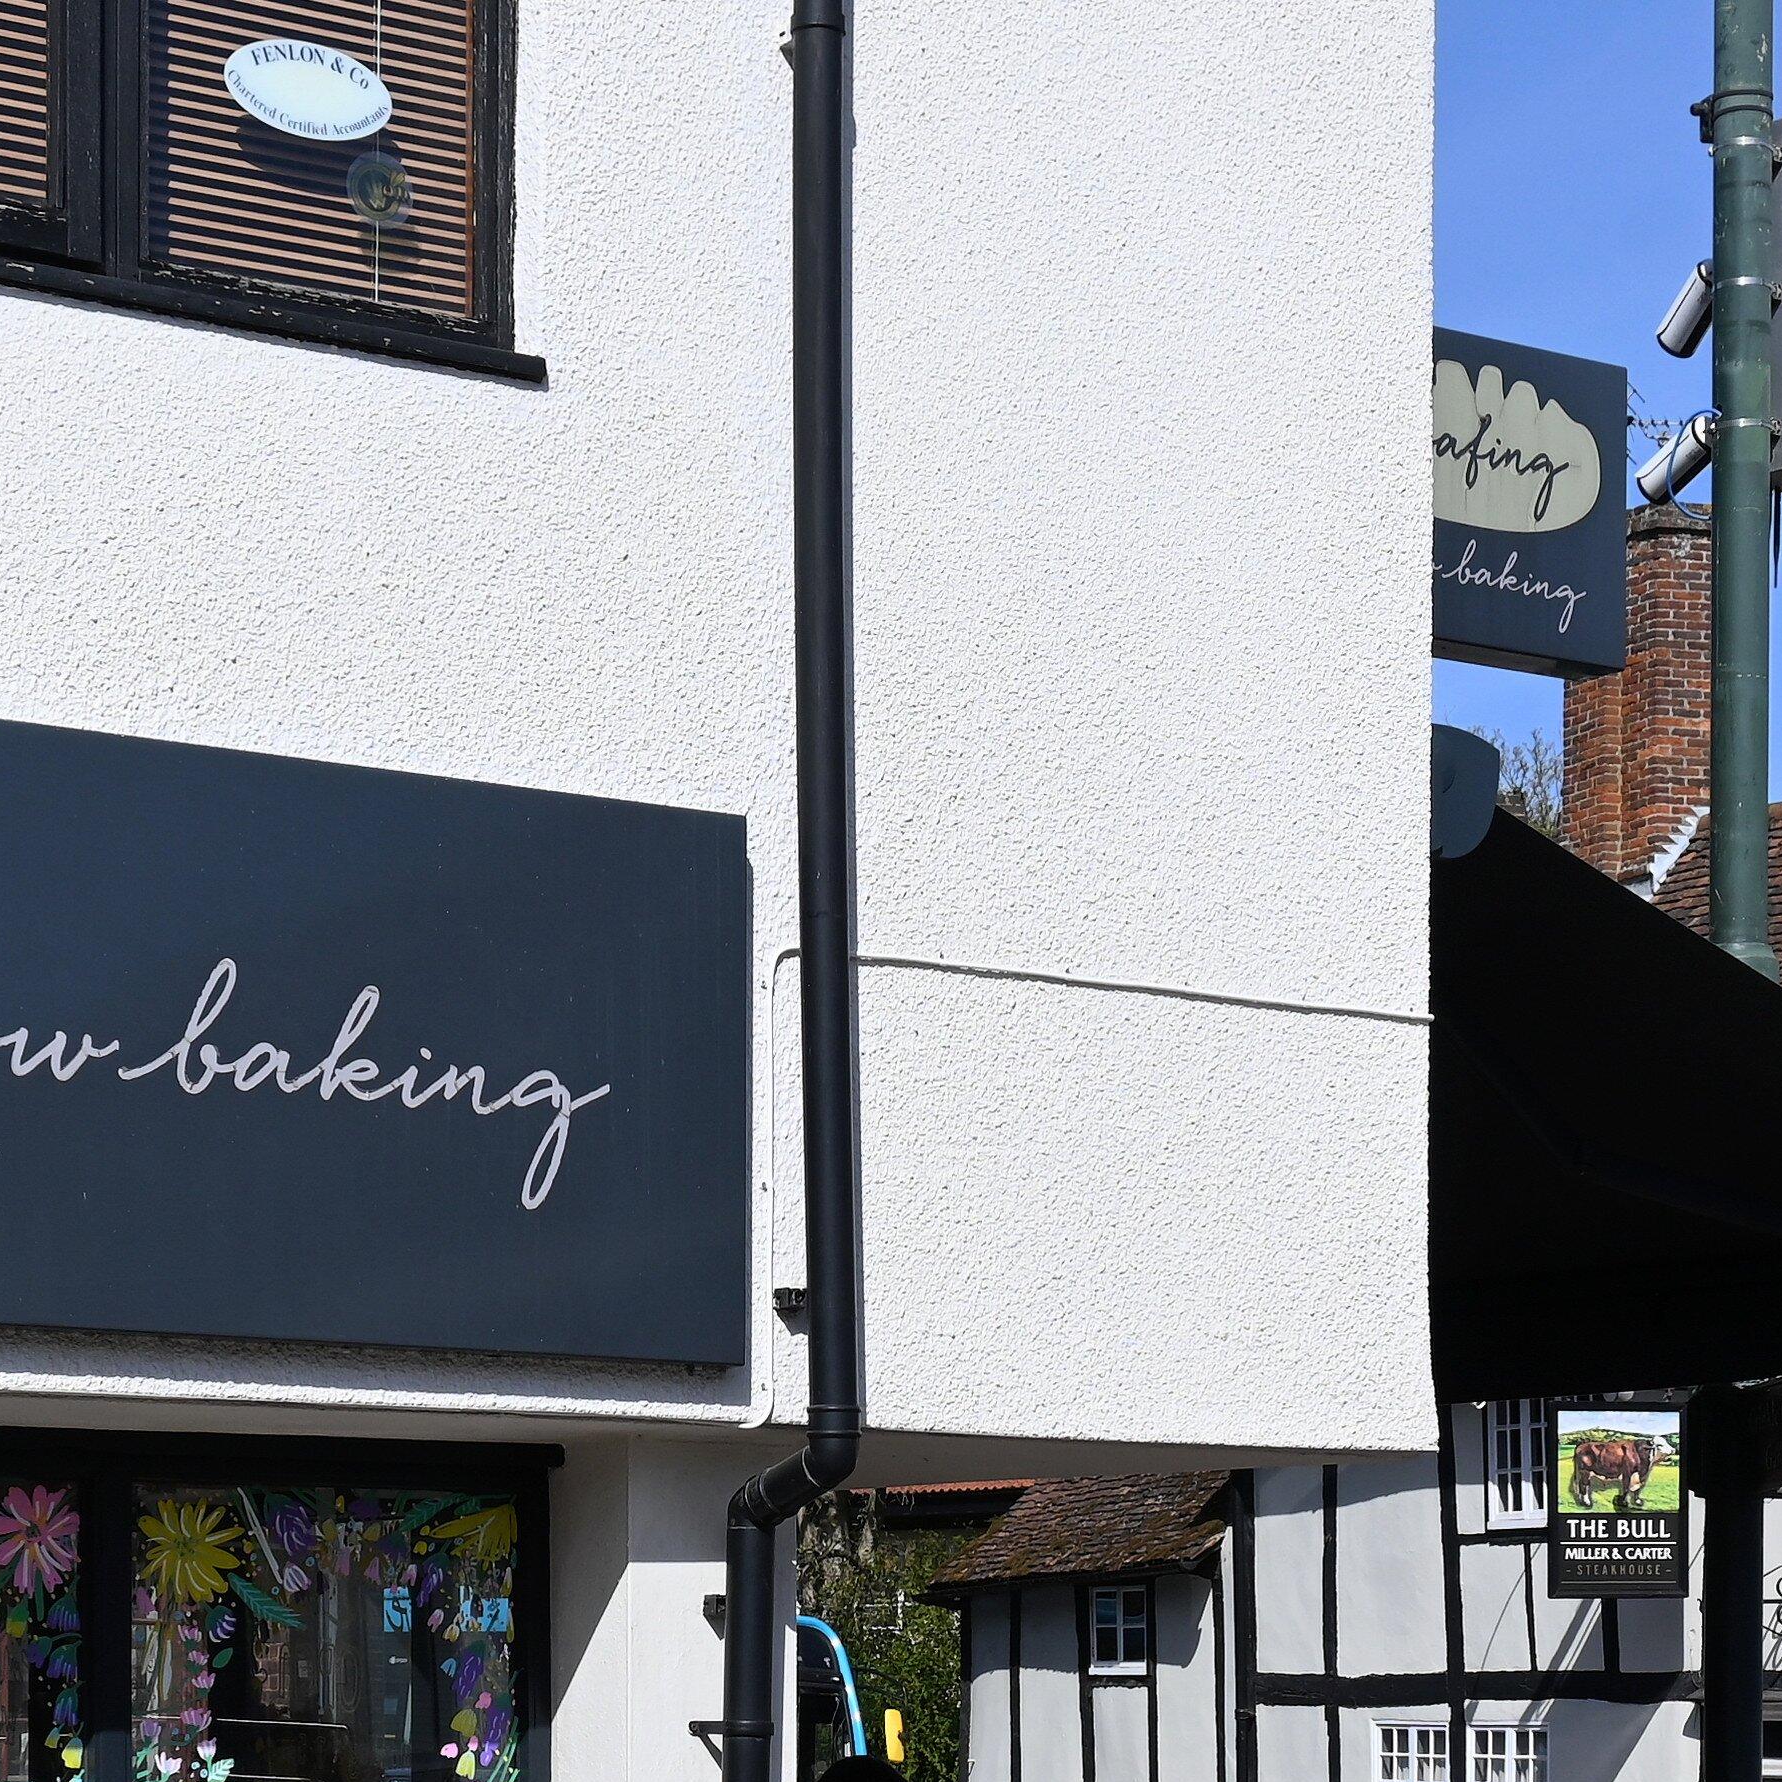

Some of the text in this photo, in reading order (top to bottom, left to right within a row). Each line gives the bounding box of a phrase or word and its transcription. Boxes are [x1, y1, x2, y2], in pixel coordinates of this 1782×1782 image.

[250, 44, 370, 90] FENLON & Co
[227, 69, 390, 137] Chartered Certified Accountants
[1432, 413, 1570, 522] afing
[1441, 538, 1587, 634] baking
[118, 957, 611, 1211] baking
[1564, 1547, 1673, 1560] MILLER & CARTER
[1566, 1518, 1672, 1539] THE BULL
[1576, 1564, 1662, 1576] STEAKHOUSE
